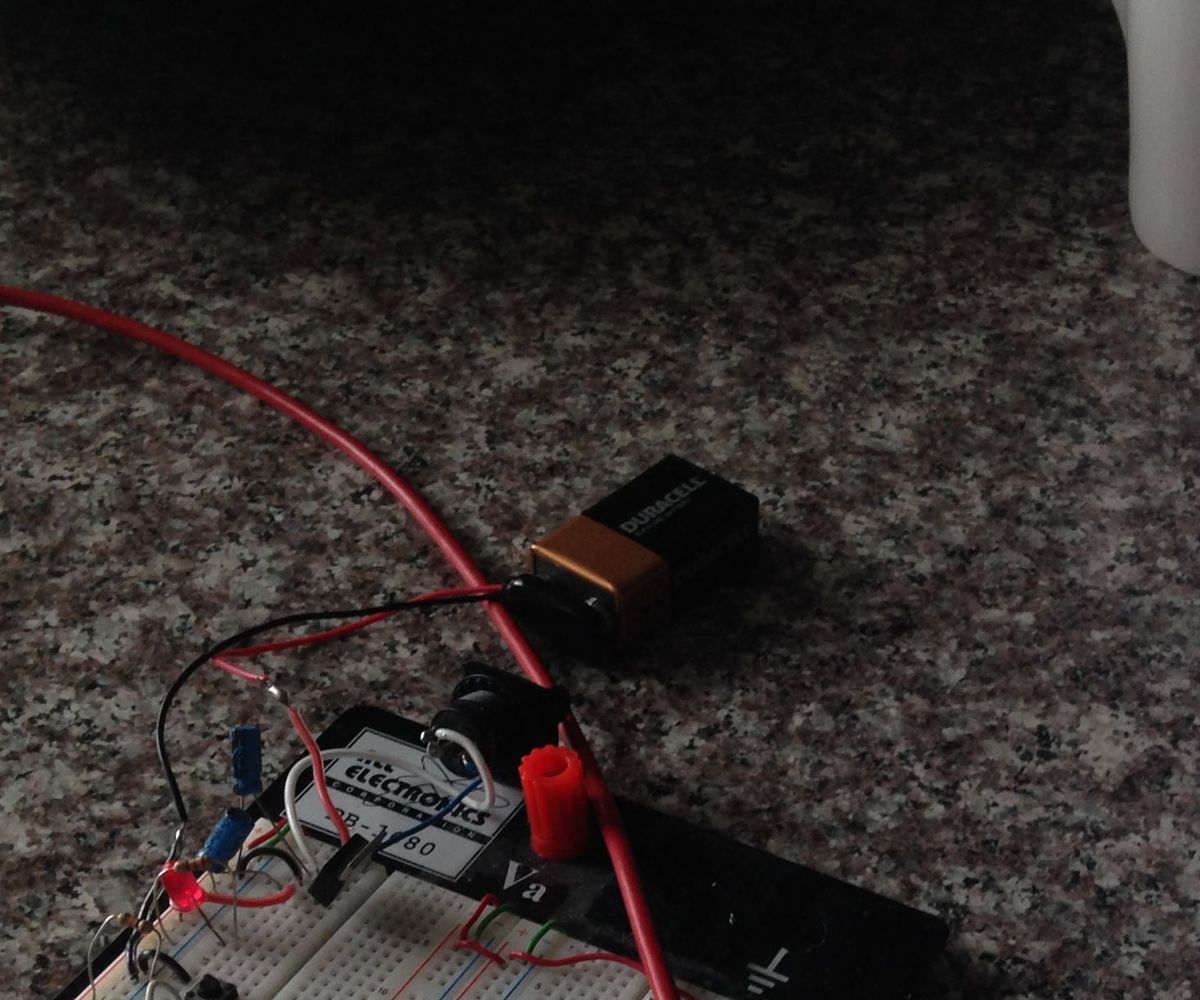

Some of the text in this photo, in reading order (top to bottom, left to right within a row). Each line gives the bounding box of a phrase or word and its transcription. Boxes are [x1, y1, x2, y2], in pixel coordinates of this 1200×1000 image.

[618, 477, 707, 534] DURACELL
[331, 781, 476, 839] CORPORAION
[501, 861, 547, 903] Va
